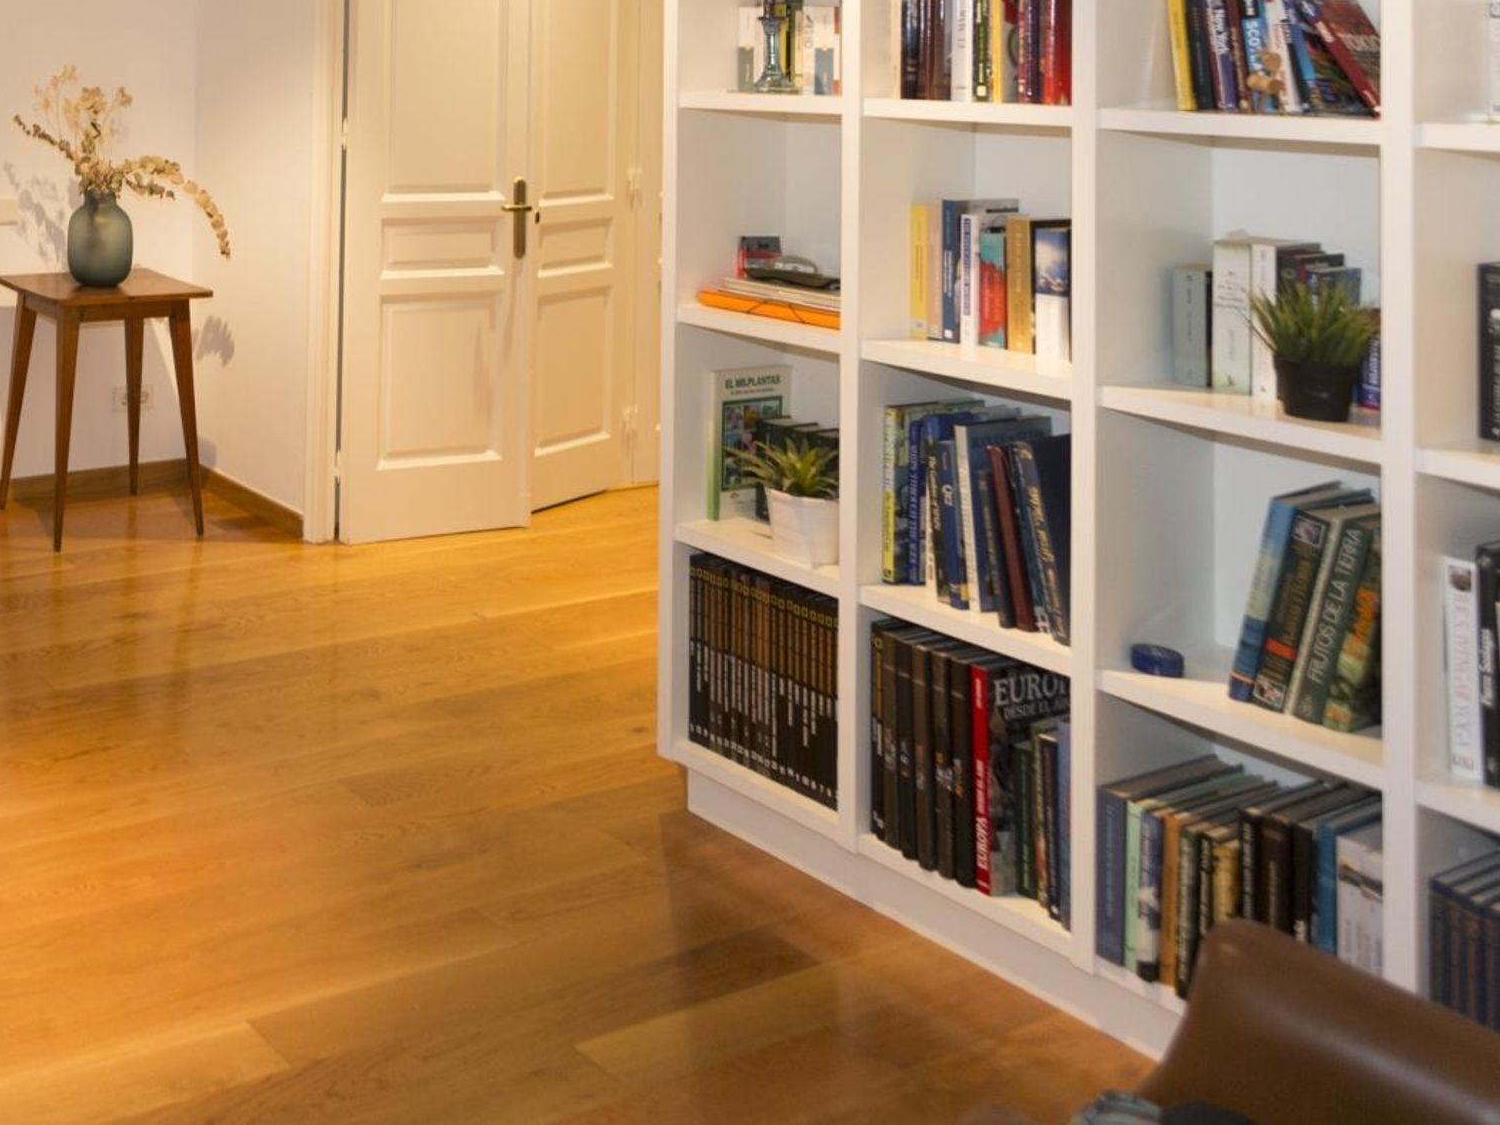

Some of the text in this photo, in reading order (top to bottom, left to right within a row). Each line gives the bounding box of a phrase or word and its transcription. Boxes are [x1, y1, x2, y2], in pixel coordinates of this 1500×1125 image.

[1308, 528, 1363, 684] FRUTOS DE LA TIERRA
[976, 817, 987, 871] EUROPA
